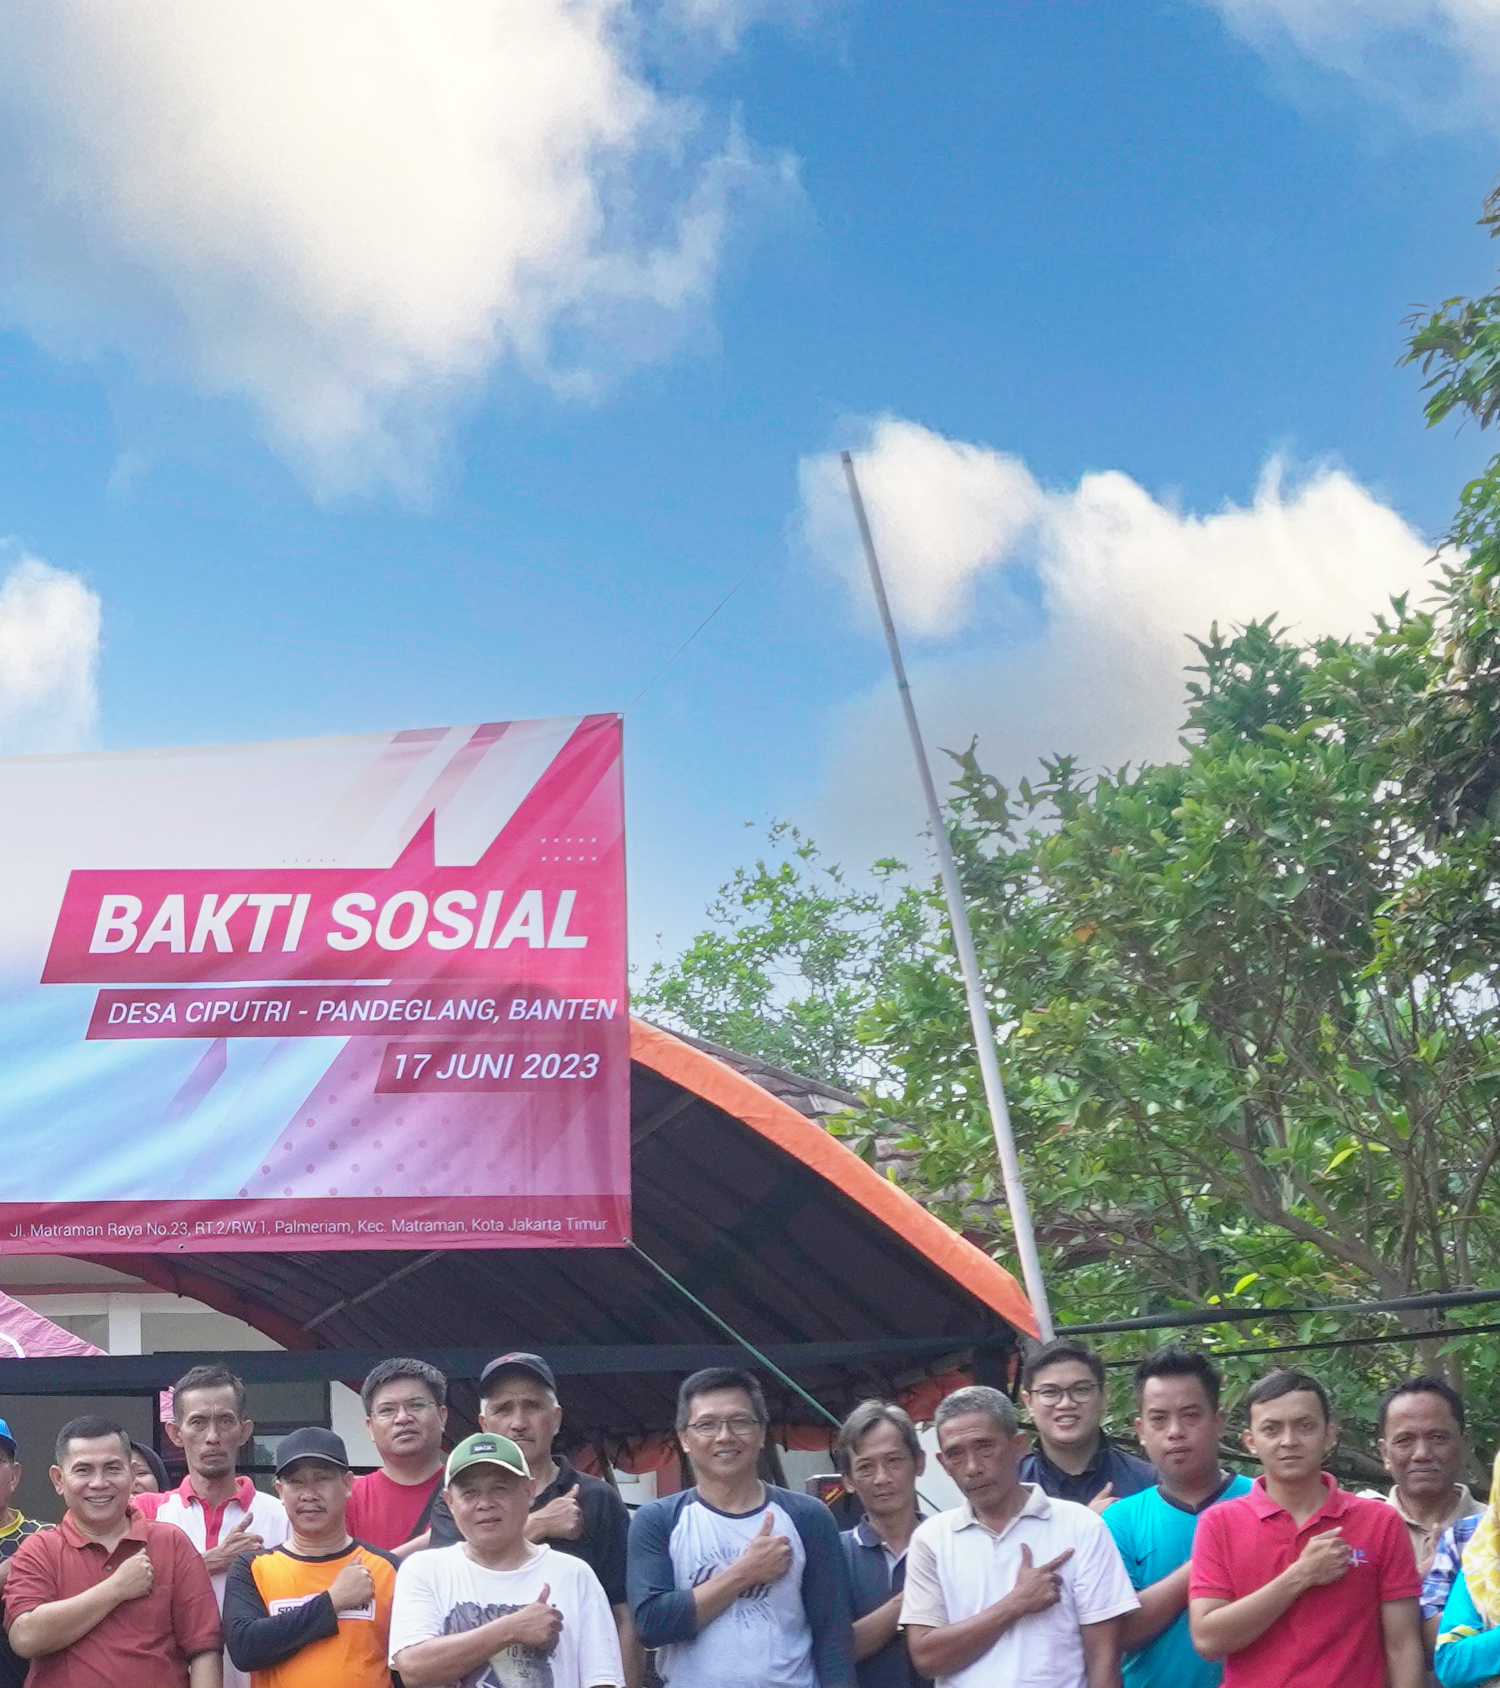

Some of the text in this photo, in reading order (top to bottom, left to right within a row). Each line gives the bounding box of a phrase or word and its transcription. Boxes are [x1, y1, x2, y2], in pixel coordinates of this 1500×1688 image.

[88, 889, 590, 954] BAKTI SOSIAL
[107, 1001, 179, 1024] DESA
[184, 999, 292, 1023] CIPUTRI
[315, 998, 500, 1025] PANDEGLANG,
[507, 997, 618, 1021] BANTEN
[394, 1052, 600, 1080] 17 JUNI 2023
[10, 1225, 26, 1238] Jl.
[30, 1224, 103, 1237] Matraman
[108, 1223, 143, 1240] Raya
[147, 1222, 191, 1237] No.23,
[275, 1219, 354, 1235] Palmeriam,
[358, 1219, 387, 1233] Kec.
[391, 1218, 468, 1235] Matraman,
[472, 1218, 504, 1232] Kota
[508, 1217, 561, 1231] Jakarta
[566, 1217, 608, 1231] Timur
